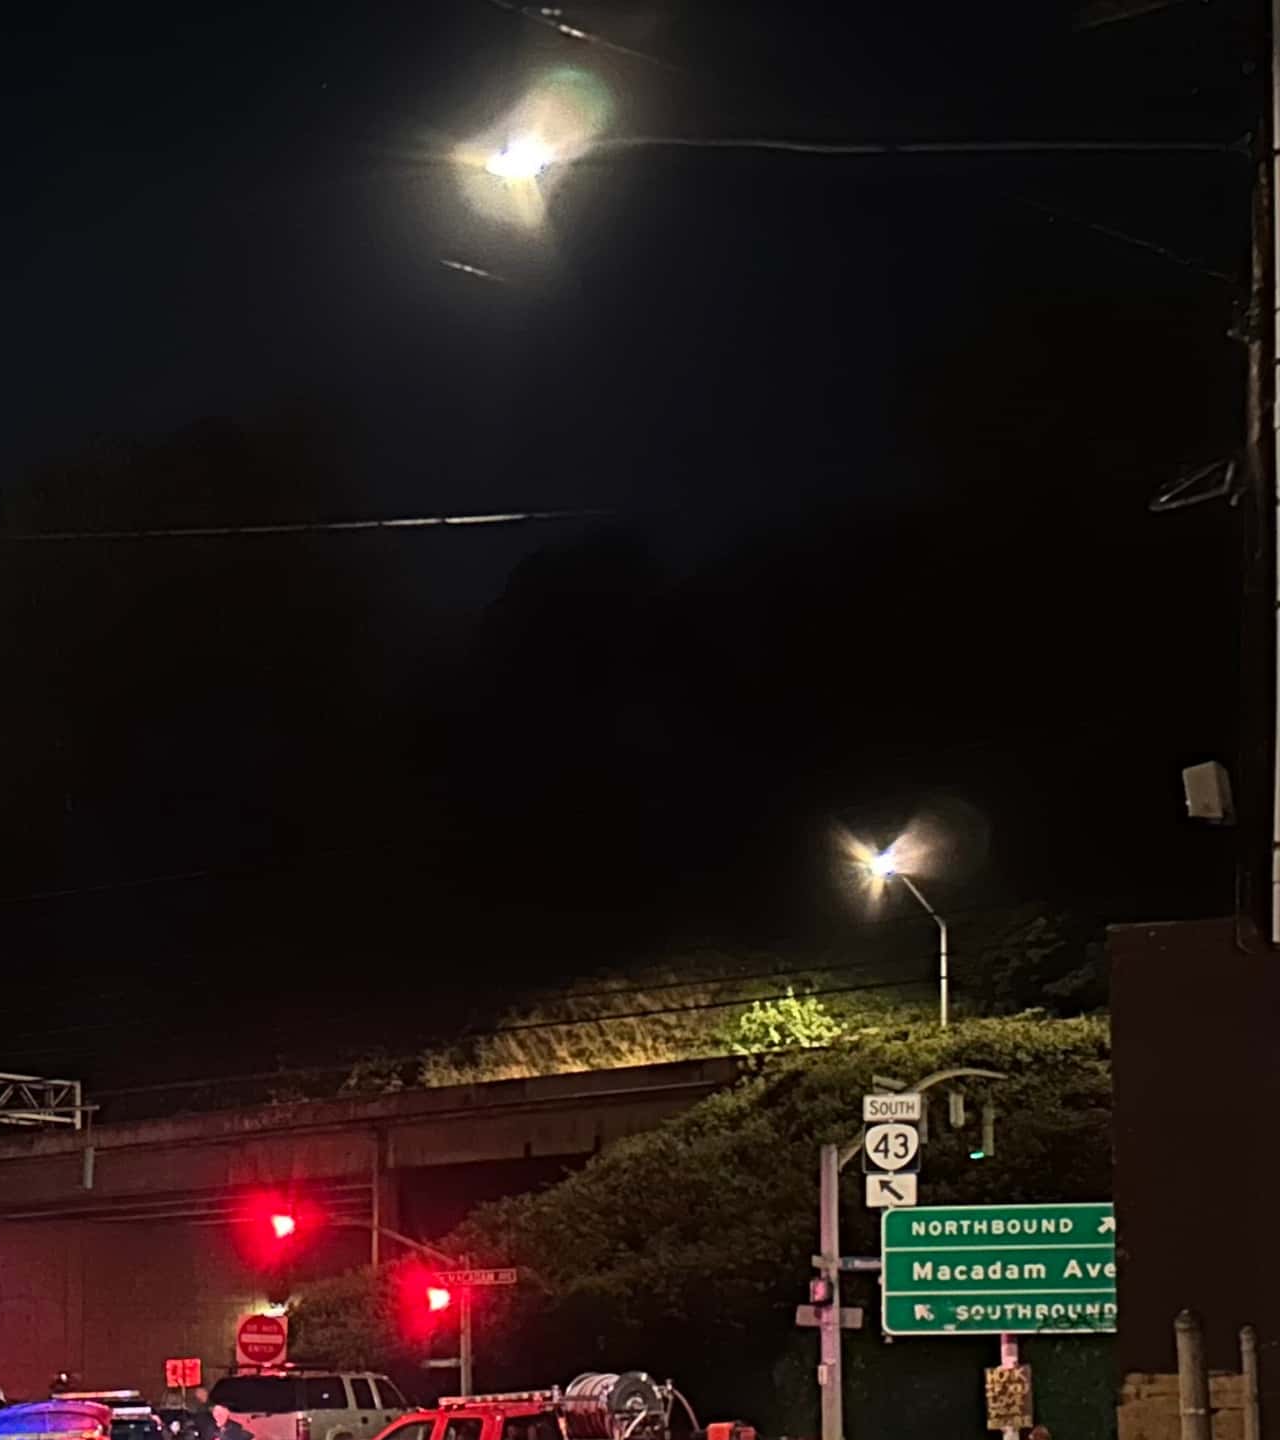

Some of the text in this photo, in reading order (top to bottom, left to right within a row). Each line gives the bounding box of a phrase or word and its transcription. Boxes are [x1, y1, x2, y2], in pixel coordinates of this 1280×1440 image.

[869, 1100, 915, 1116] SOUTH
[873, 1133, 909, 1160] 43
[911, 1217, 1074, 1238] NORTHBOUND
[912, 1260, 1046, 1282] Macadam
